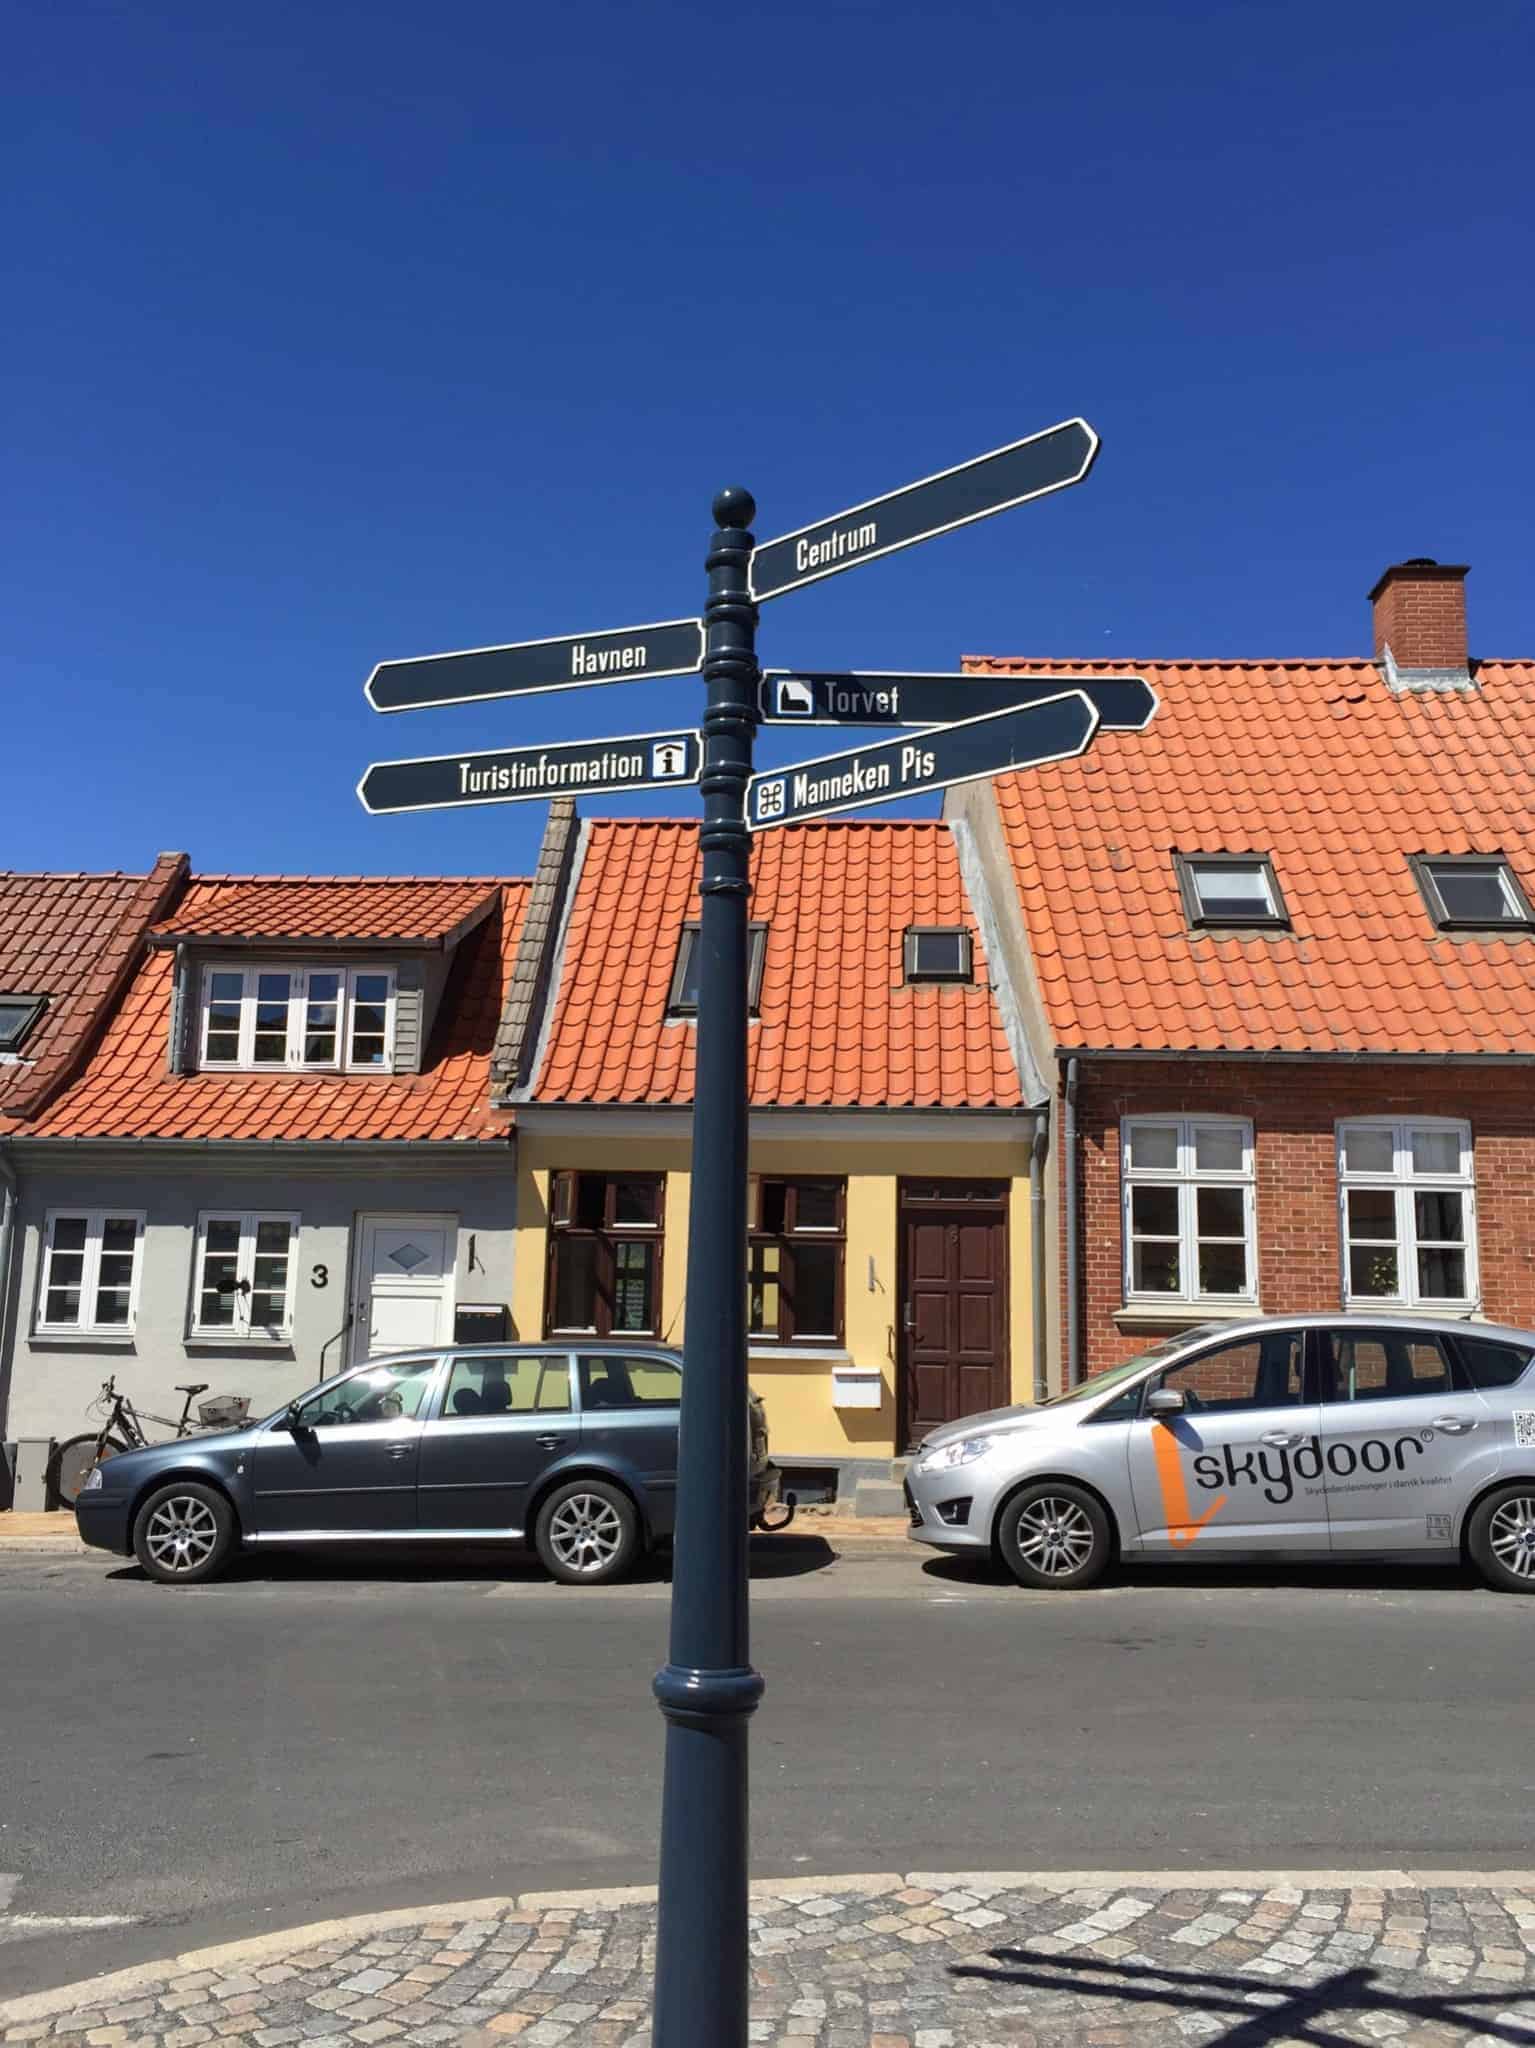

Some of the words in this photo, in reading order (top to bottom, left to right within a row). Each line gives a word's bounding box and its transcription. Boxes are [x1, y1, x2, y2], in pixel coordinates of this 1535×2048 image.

[797, 522, 877, 571] Centrum
[571, 645, 647, 675] Havnen
[825, 682, 899, 714] Torvet
[459, 754, 643, 794] Turistinformation
[793, 760, 889, 809] Manneken
[901, 746, 935, 782] Pis
[311, 1264, 328, 1288] 3
